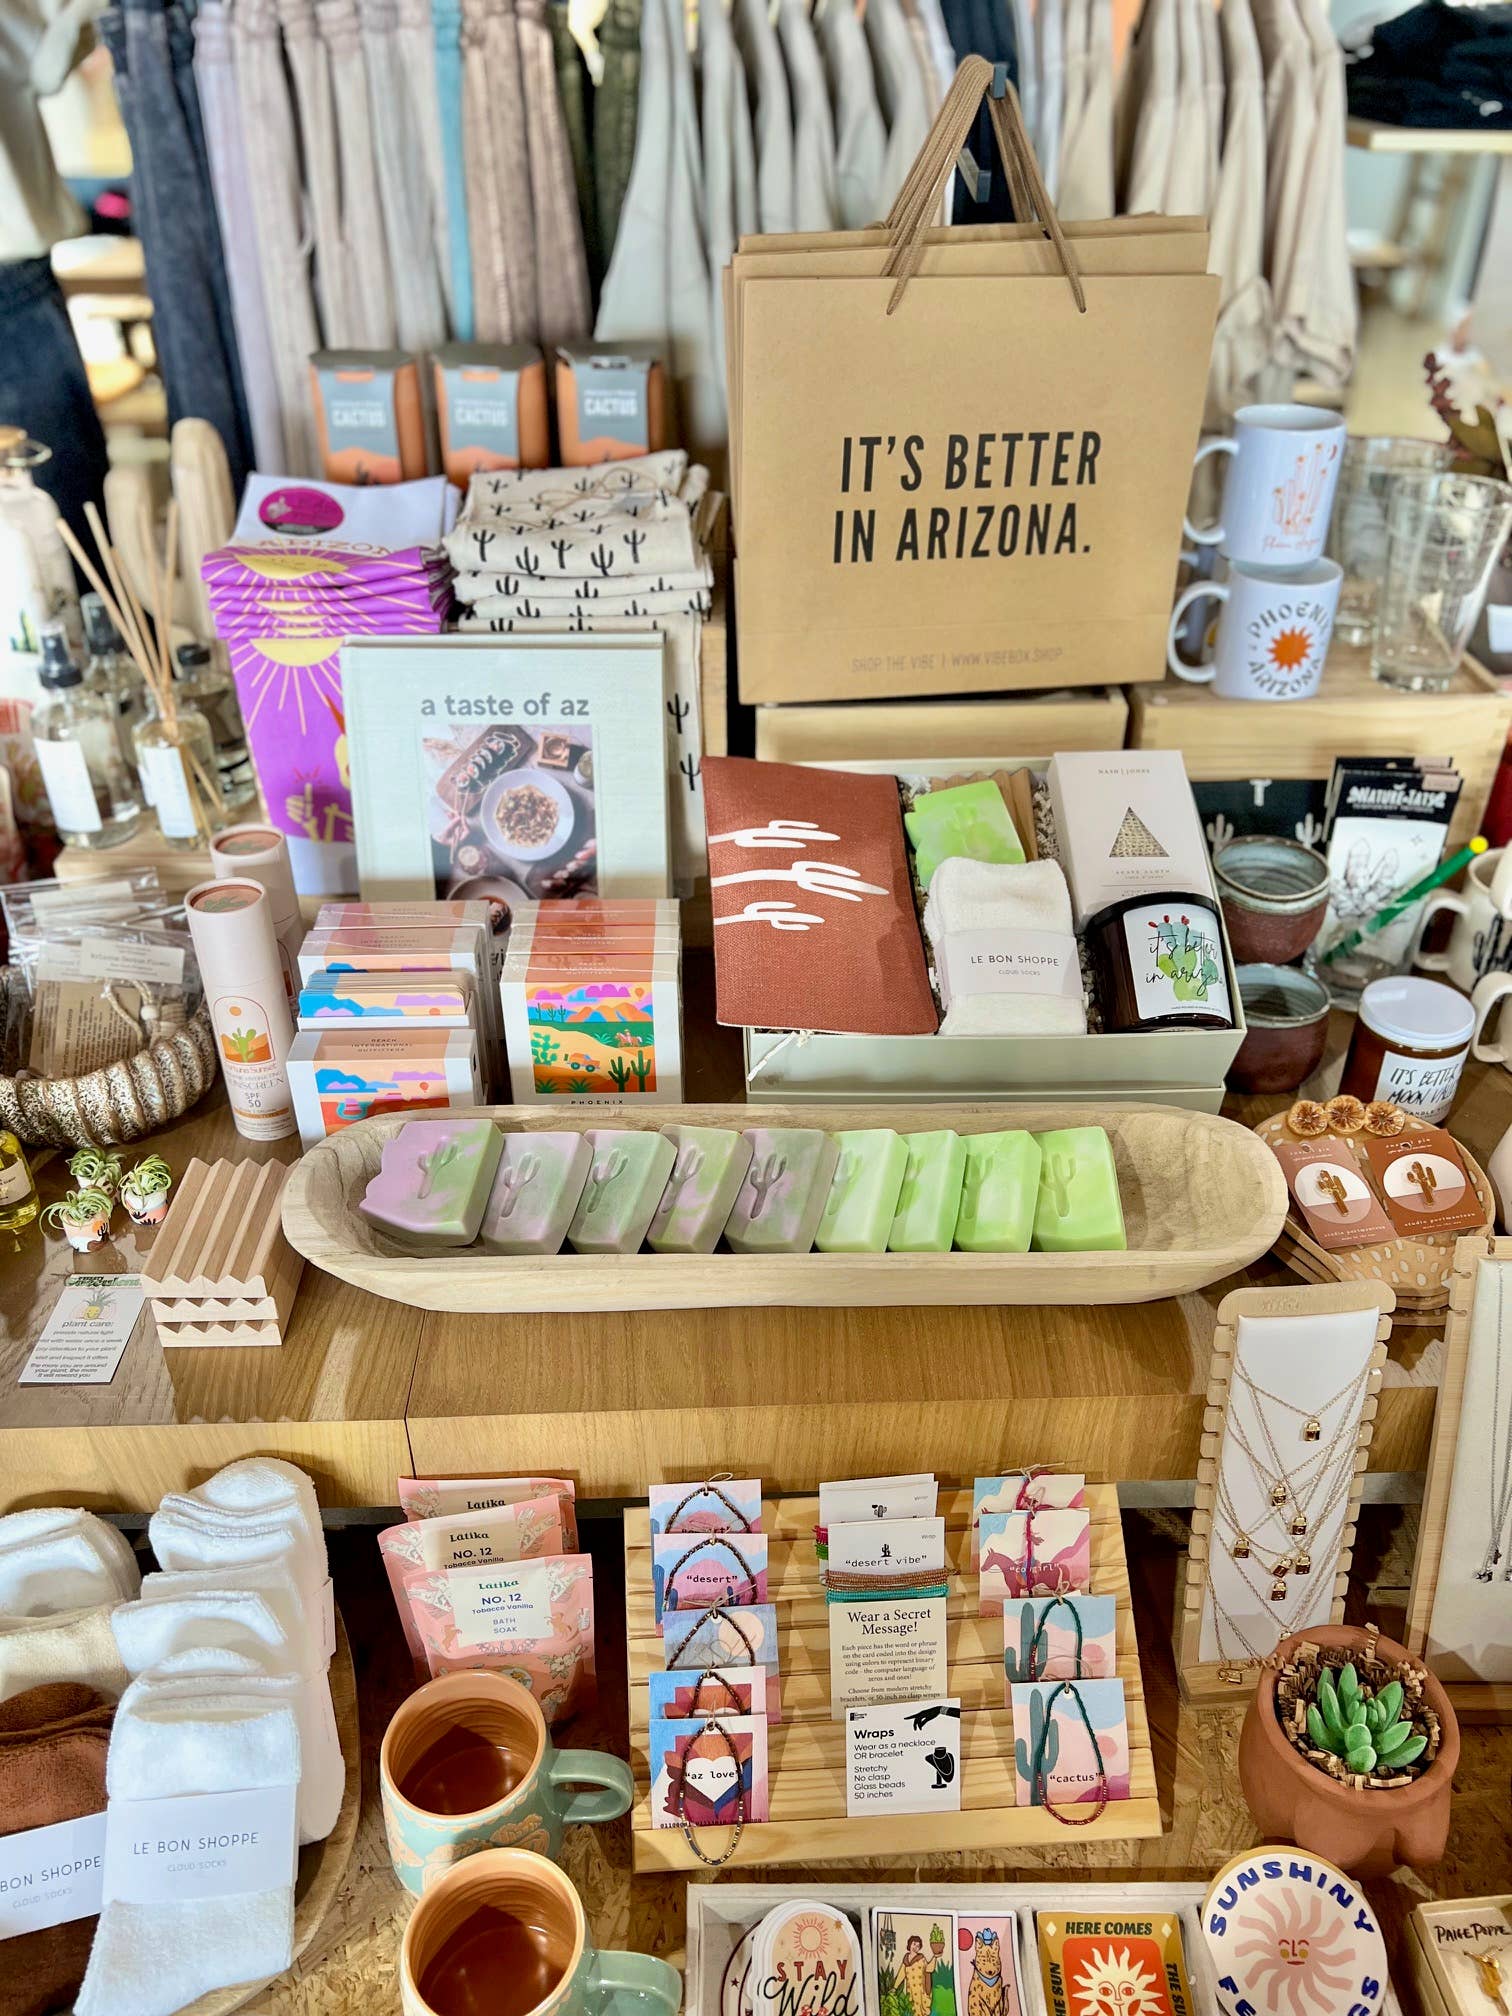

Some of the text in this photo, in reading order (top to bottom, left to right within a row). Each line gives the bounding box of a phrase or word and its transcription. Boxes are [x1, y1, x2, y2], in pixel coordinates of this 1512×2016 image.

[584, 397, 637, 416] CACTUS
[332, 408, 386, 428] CACTUS
[455, 406, 507, 427] CACTUS
[945, 431, 1101, 490] BETTER
[833, 502, 1091, 563] IN ARIZONA.
[851, 657, 882, 673] SHOP
[887, 655, 905, 671] THE
[911, 654, 935, 670] VIBE
[1248, 657, 1322, 696] ARIZONA
[421, 692, 590, 717] a taste of az
[971, 955, 1060, 967] LE BON SHOPPE
[248, 1099, 262, 1108] 50
[1386, 1089, 1432, 1106] MOON
[62, 1320, 87, 1328] plant
[453, 1547, 493, 1560] NO. 12
[444, 1556, 505, 1570] Tobacco Vanilla
[481, 1593, 522, 1605] NO. 12
[472, 1606, 505, 1615] Tobacco
[847, 1608, 932, 1623] Wear a Secret
[861, 1621, 918, 1637] Message!
[857, 1644, 872, 1652] piece
[918, 1640, 938, 1648] phrase
[876, 1650, 894, 1658] coded
[918, 1647, 937, 1656] design
[873, 1666, 902, 1674] computer
[902, 1665, 928, 1673] language
[928, 1663, 936, 1671] of
[887, 1658, 914, 1666] represent
[909, 1683, 932, 1691] stretchy
[907, 1692, 922, 1700] clasp
[922, 1692, 941, 1700] wraps
[854, 1729, 895, 1740] Wraps
[898, 1739, 937, 1748] necklace
[853, 1750, 904, 1760] OR bracelet
[854, 1764, 888, 1774] Stretchy
[854, 1773, 891, 1782] No clasp
[853, 1781, 906, 1791] Glass beads
[854, 1791, 894, 1800] 50 inches
[133, 1832, 260, 1855] LE BON SHOPPE
[167, 1859, 228, 1873] CLOUD SOCKS
[0, 1855, 102, 1893] BON SHOPPE
[12, 1887, 73, 1910] CLOUD SOCKS
[1210, 1861, 1375, 1937] SUNSHINY
[1065, 1921, 1153, 1935] HERE COMES
[1470, 1922, 1511, 1939] POPPE
[776, 1959, 849, 1983] STAY
[1049, 1961, 1064, 1997] SUN
[756, 1970, 860, 2016] Wild
[1165, 1962, 1187, 2016] THE SU
